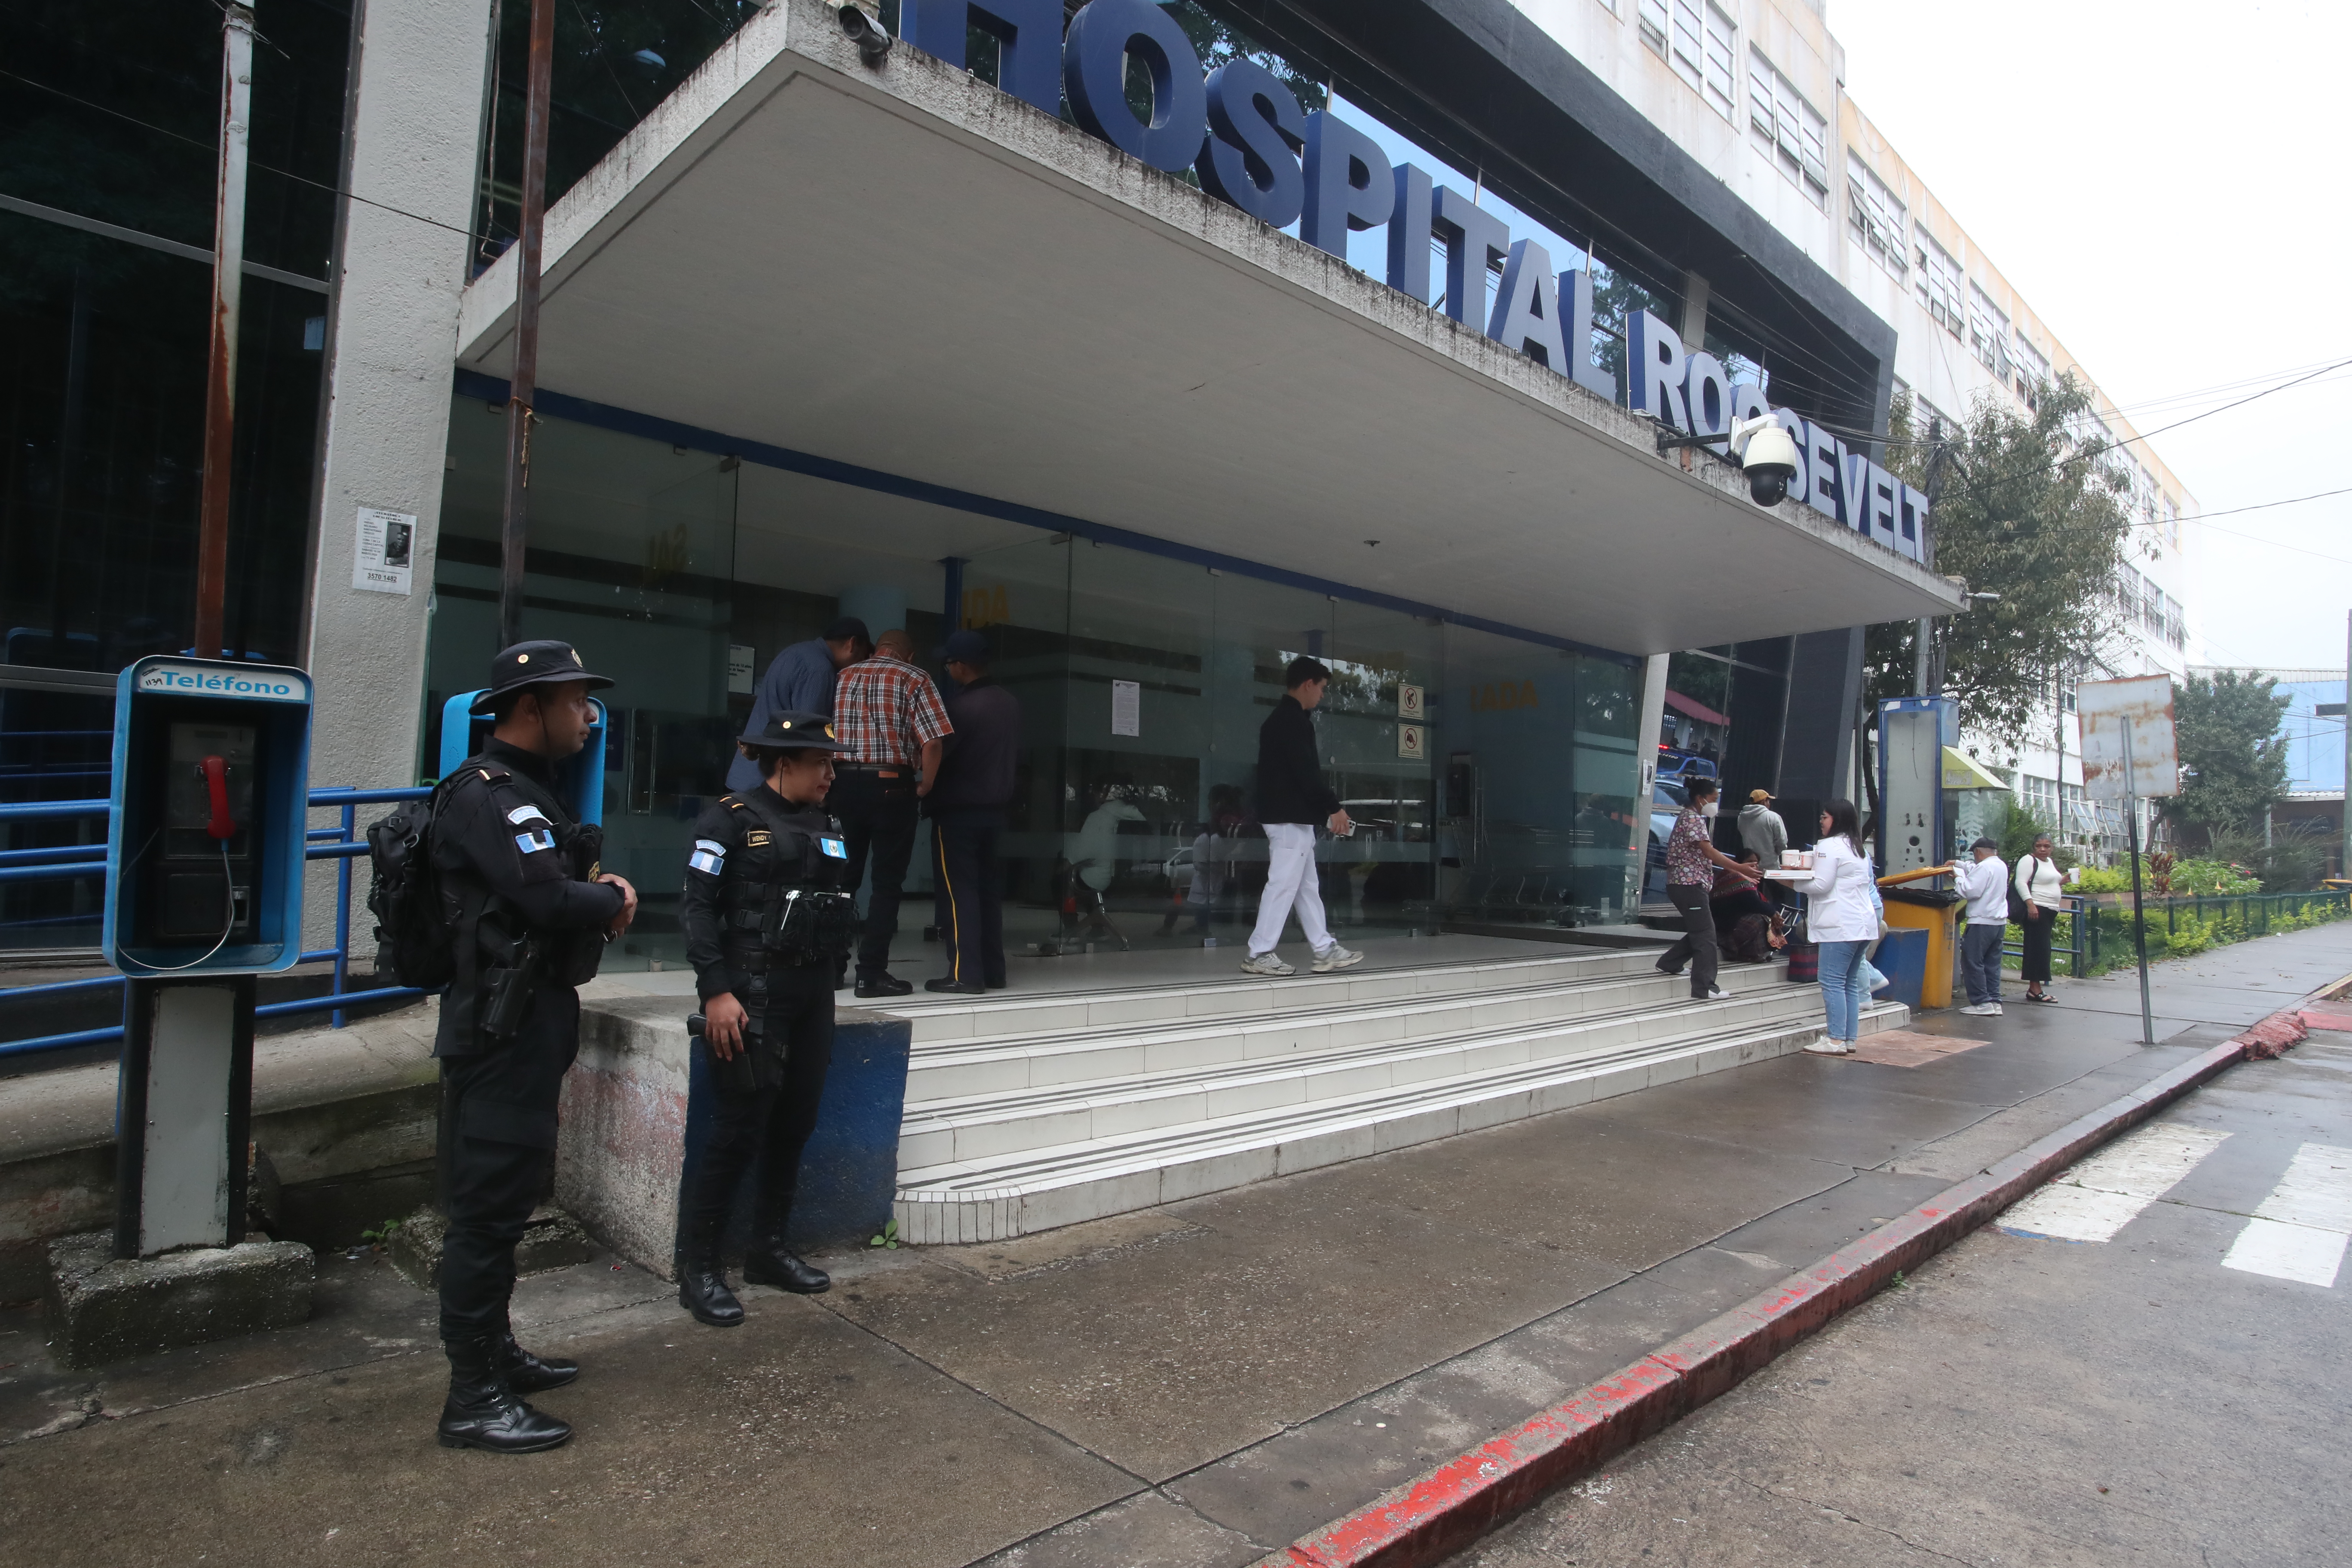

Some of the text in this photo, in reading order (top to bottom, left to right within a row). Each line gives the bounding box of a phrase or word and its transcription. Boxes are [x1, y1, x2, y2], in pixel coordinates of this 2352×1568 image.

[145, 678, 163, 686] 1139
[160, 671, 290, 695] Teléfono
[698, 842, 723, 854] GUATEMALA
